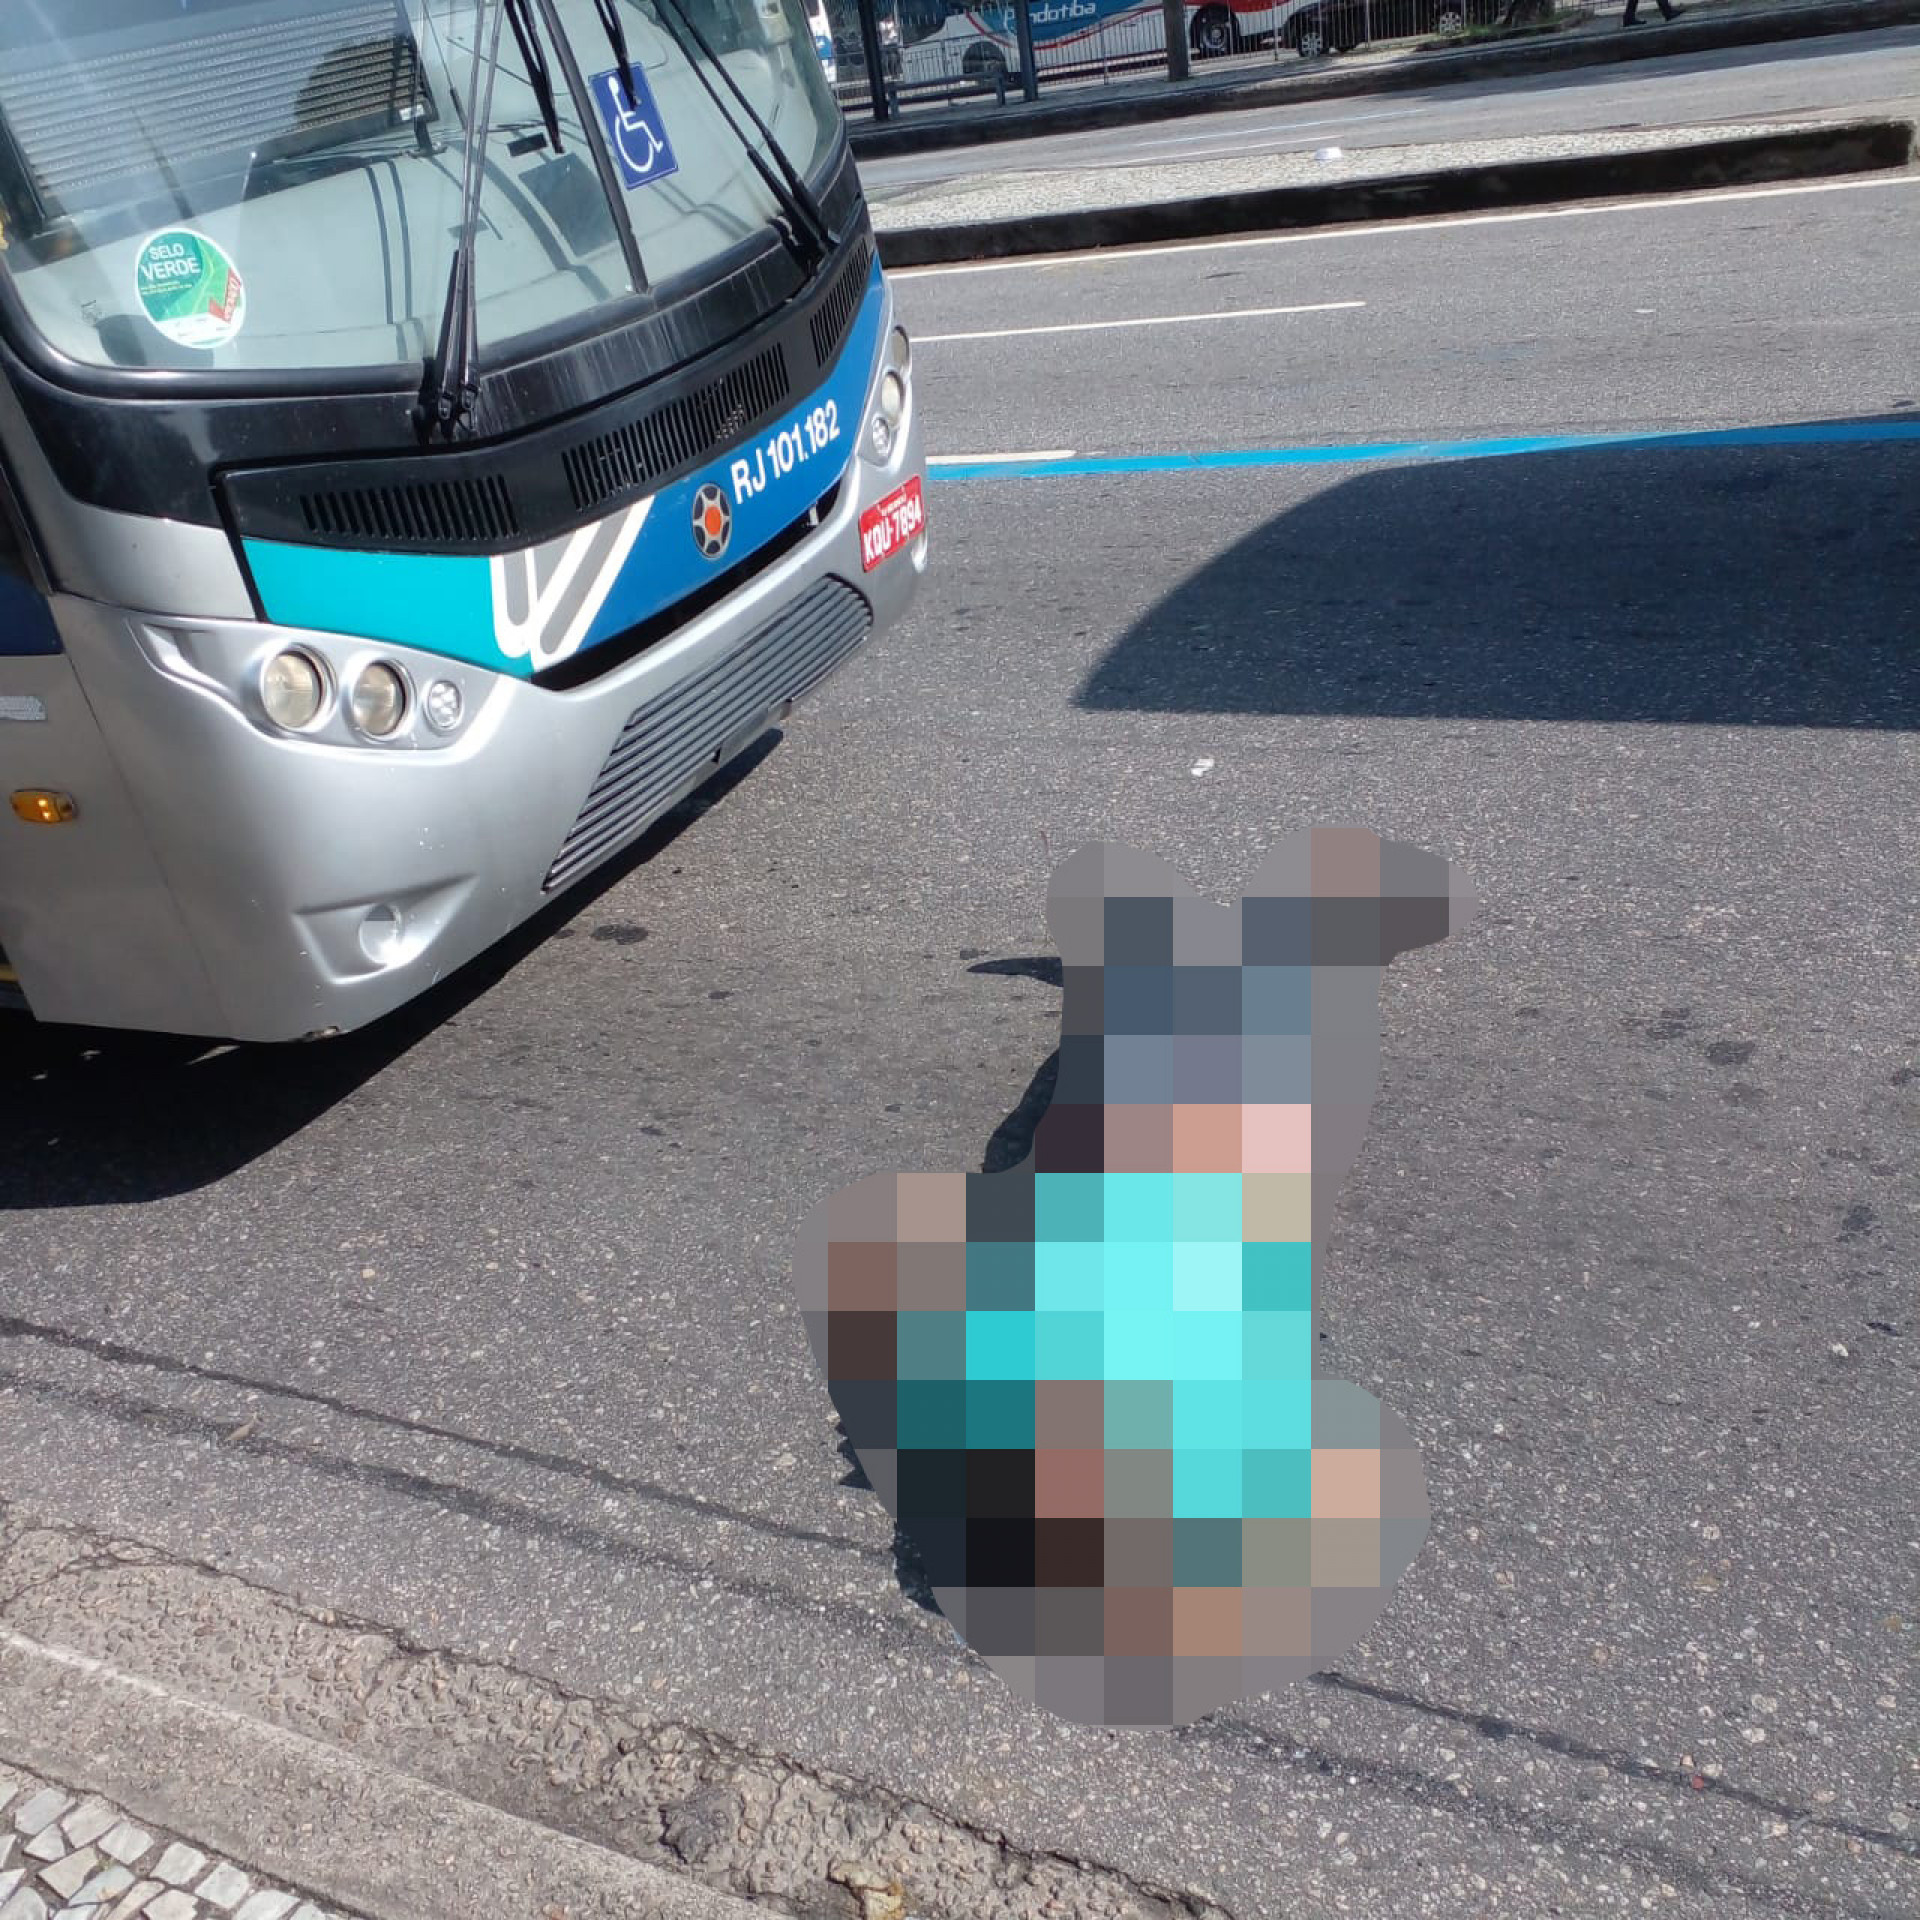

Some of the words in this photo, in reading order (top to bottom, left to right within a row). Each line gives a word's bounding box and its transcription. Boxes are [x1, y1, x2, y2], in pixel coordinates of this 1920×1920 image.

[1003, 0, 1097, 26] Pndotiba
[149, 242, 184, 260] SELO
[140, 257, 201, 281] VERDE
[731, 447, 767, 505] RJ
[767, 399, 841, 480] 101.182
